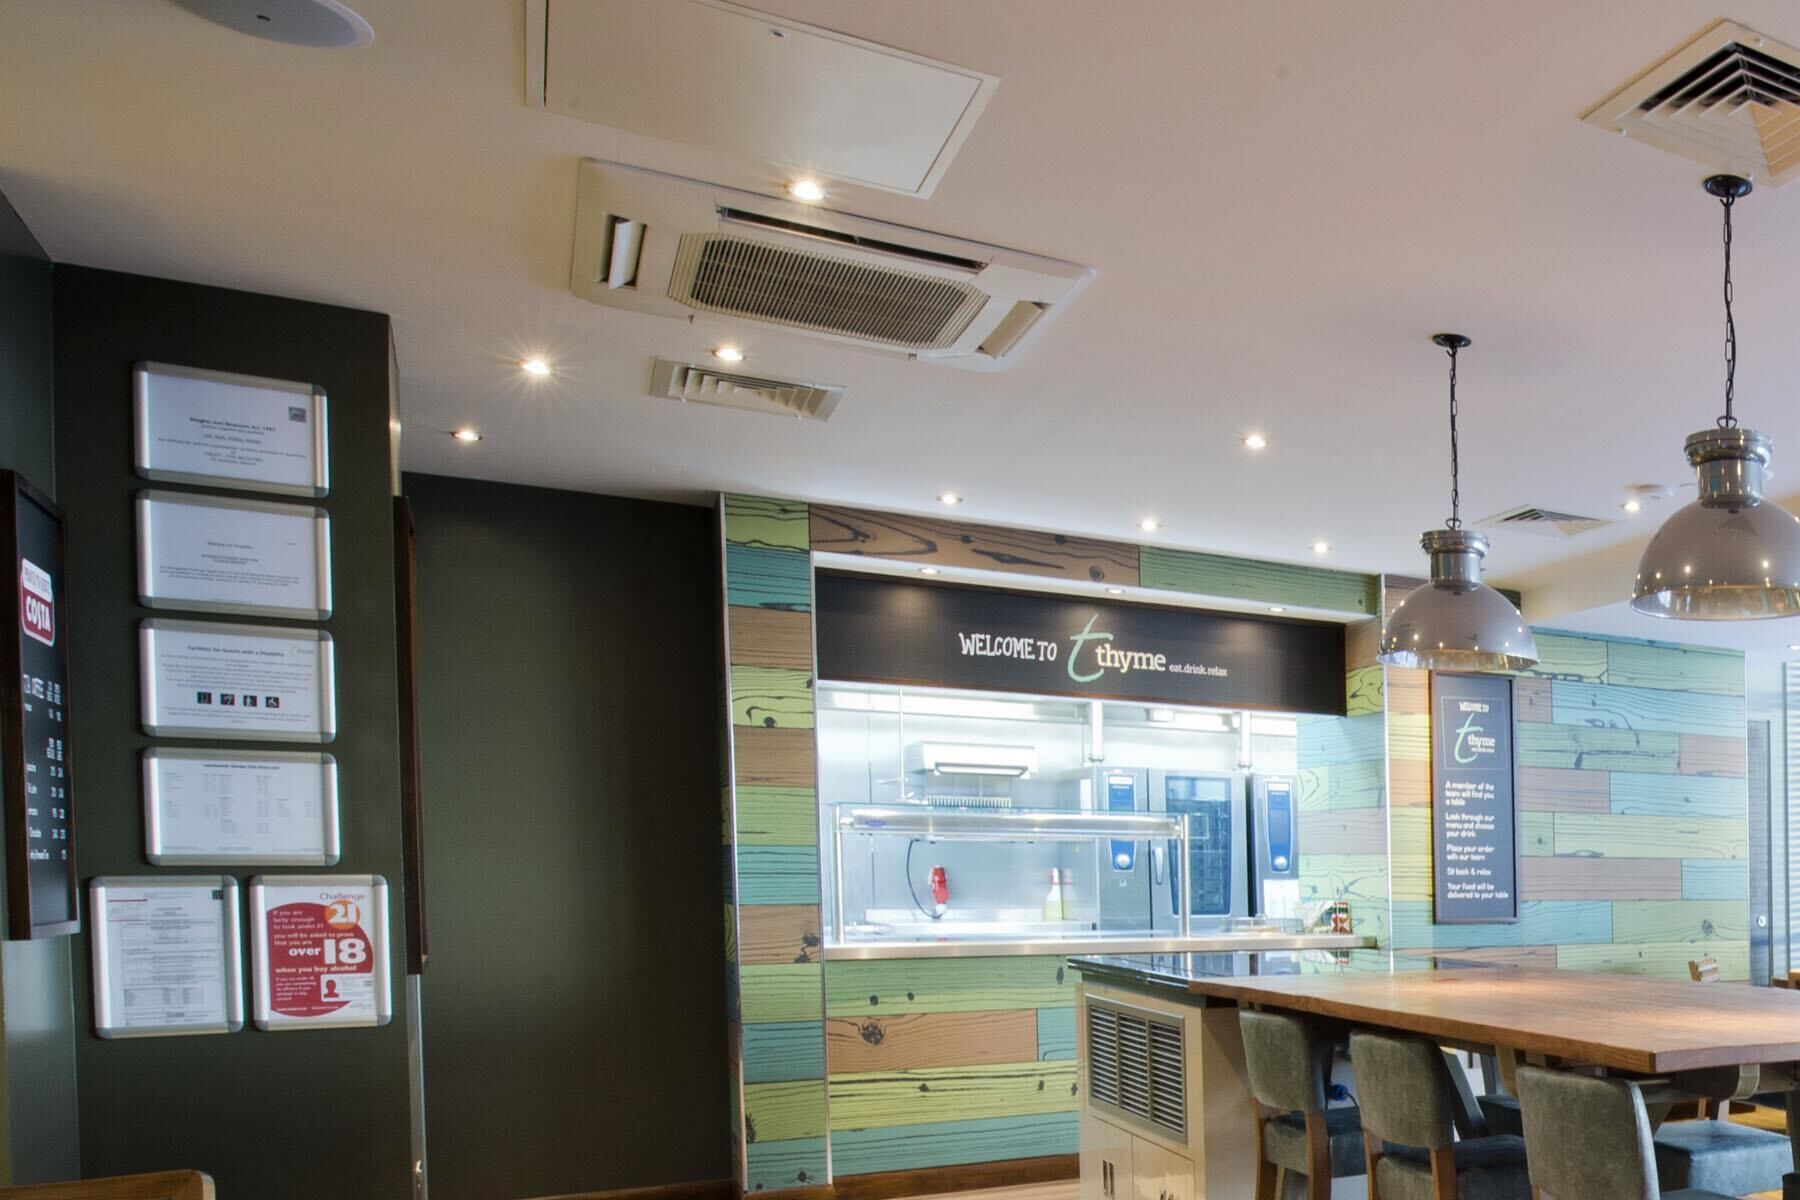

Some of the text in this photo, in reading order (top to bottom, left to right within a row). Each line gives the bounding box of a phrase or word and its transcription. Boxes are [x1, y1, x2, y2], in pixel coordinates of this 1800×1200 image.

[25, 595, 51, 633] COSTA
[958, 632, 1036, 660] WELCOME
[1036, 641, 1057, 662] TO
[1095, 644, 1167, 673] thyme
[1168, 663, 1228, 677] eat.drink.relax
[1467, 733, 1496, 748] thyme
[1451, 782, 1477, 791] member
[1485, 783, 1495, 791] the
[1445, 789, 1495, 801] team will find you
[1451, 797, 1466, 806] table
[1445, 812, 1460, 821] Look
[1461, 813, 1484, 824] through
[1445, 821, 1495, 831] menu and choose
[1446, 830, 1477, 840] your drink
[1446, 843, 1496, 855] Place your order
[1446, 852, 1458, 861] with
[1470, 853, 1486, 861] team
[1447, 866, 1455, 876] Sit
[1455, 866, 1470, 876] back
[1476, 867, 1492, 876] relax
[1447, 882, 1462, 891] Your
[1462, 882, 1476, 891] food
[1476, 882, 1486, 891] will
[319, 892, 366, 902] Challenge
[1447, 890, 1474, 900] delivered
[1481, 892, 1495, 901] your
[1495, 890, 1509, 899] table
[327, 903, 358, 924] 21
[288, 937, 367, 965] over 18
[275, 964, 357, 974] when you buy alcohol
